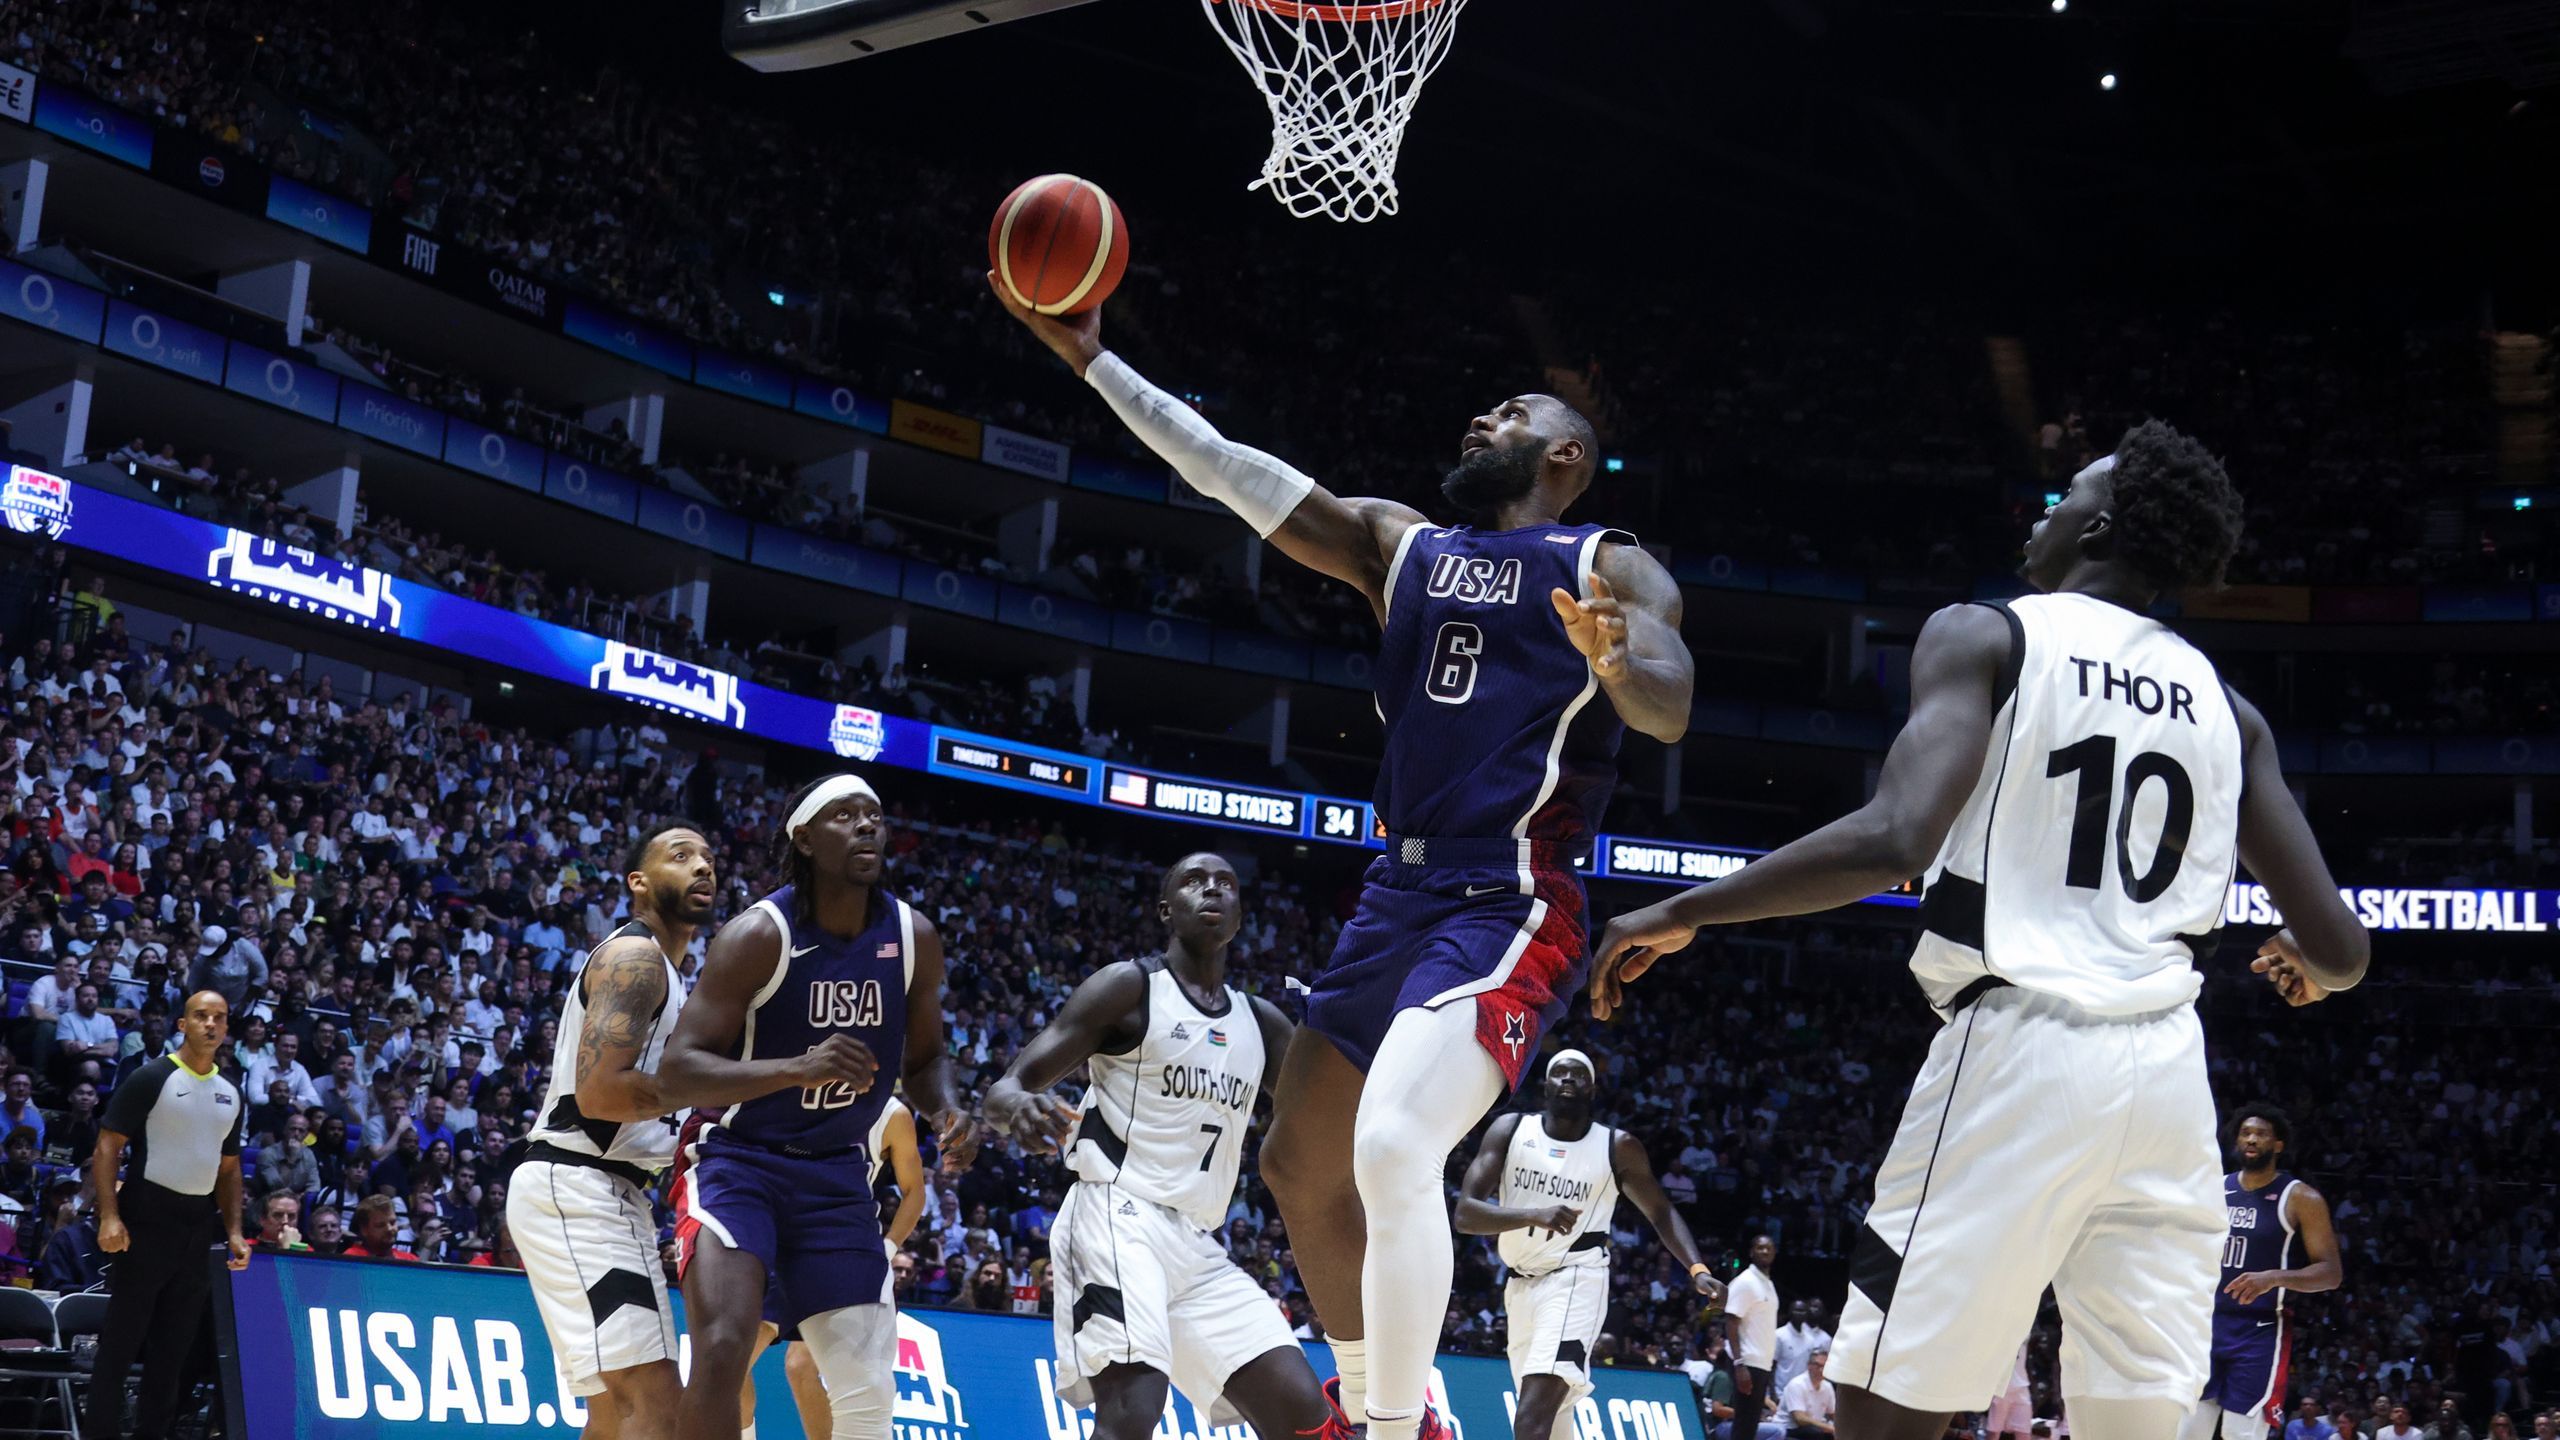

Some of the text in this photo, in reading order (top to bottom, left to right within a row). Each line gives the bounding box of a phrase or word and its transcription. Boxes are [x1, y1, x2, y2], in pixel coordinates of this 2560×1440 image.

[403, 232, 440, 275] FIAT
[488, 267, 546, 305] QATAR
[364, 399, 424, 439] Priority
[1427, 553, 1522, 605] USA
[1425, 622, 1483, 704] 6
[2069, 656, 2197, 726] THOR
[952, 745, 1073, 785] TIMEOUTS 1 FOULS 4
[1155, 782, 1294, 826] UNITED STATES
[1324, 806, 1355, 836] 34
[2046, 734, 2194, 904] 10
[1613, 845, 1679, 874] SOUTH
[2226, 884, 2284, 926] US
[808, 979, 883, 1028] USA
[1161, 1064, 1220, 1102] SOUTH
[1199, 1123, 1223, 1172] 7
[1514, 1167, 1593, 1202] SOUTH SUDAN
